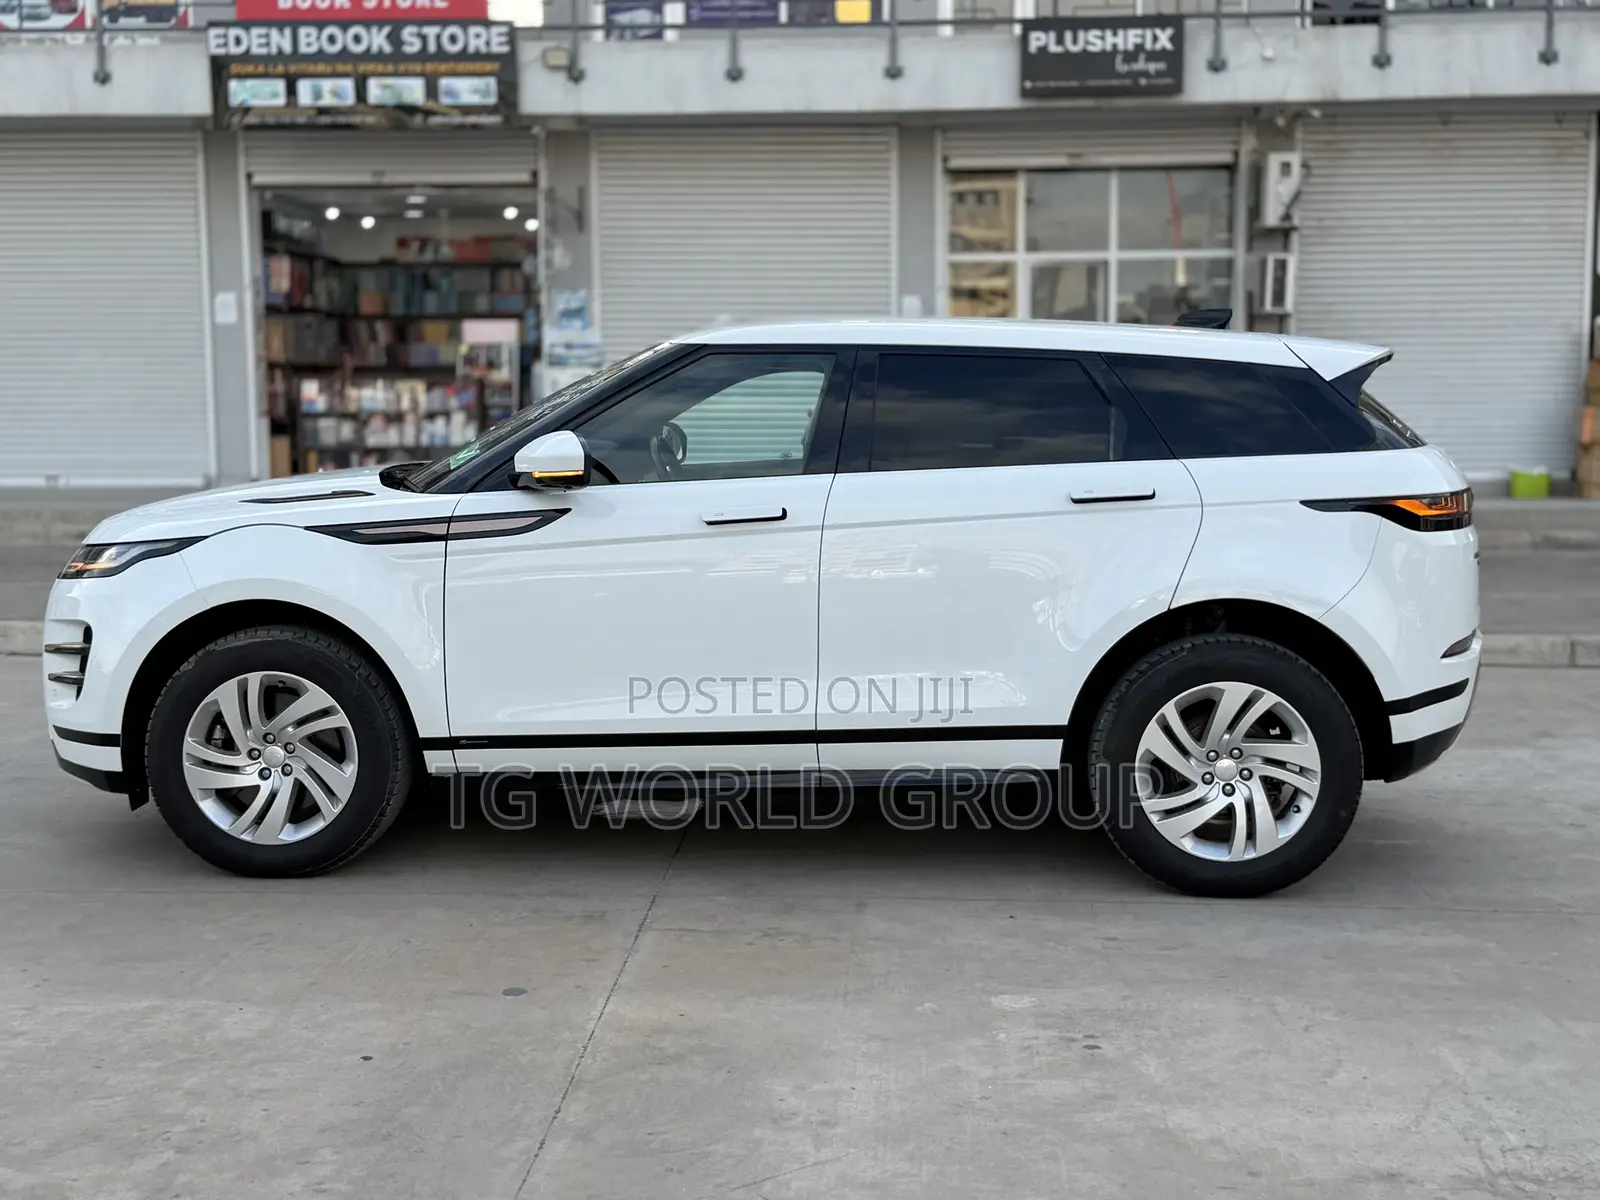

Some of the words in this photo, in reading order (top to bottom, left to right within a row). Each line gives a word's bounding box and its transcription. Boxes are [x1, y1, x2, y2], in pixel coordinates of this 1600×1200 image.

[207, 26, 292, 55] EDEN
[297, 25, 394, 55] BOOK
[400, 24, 510, 55] STORE
[1028, 27, 1175, 54] PLUSHFIX
